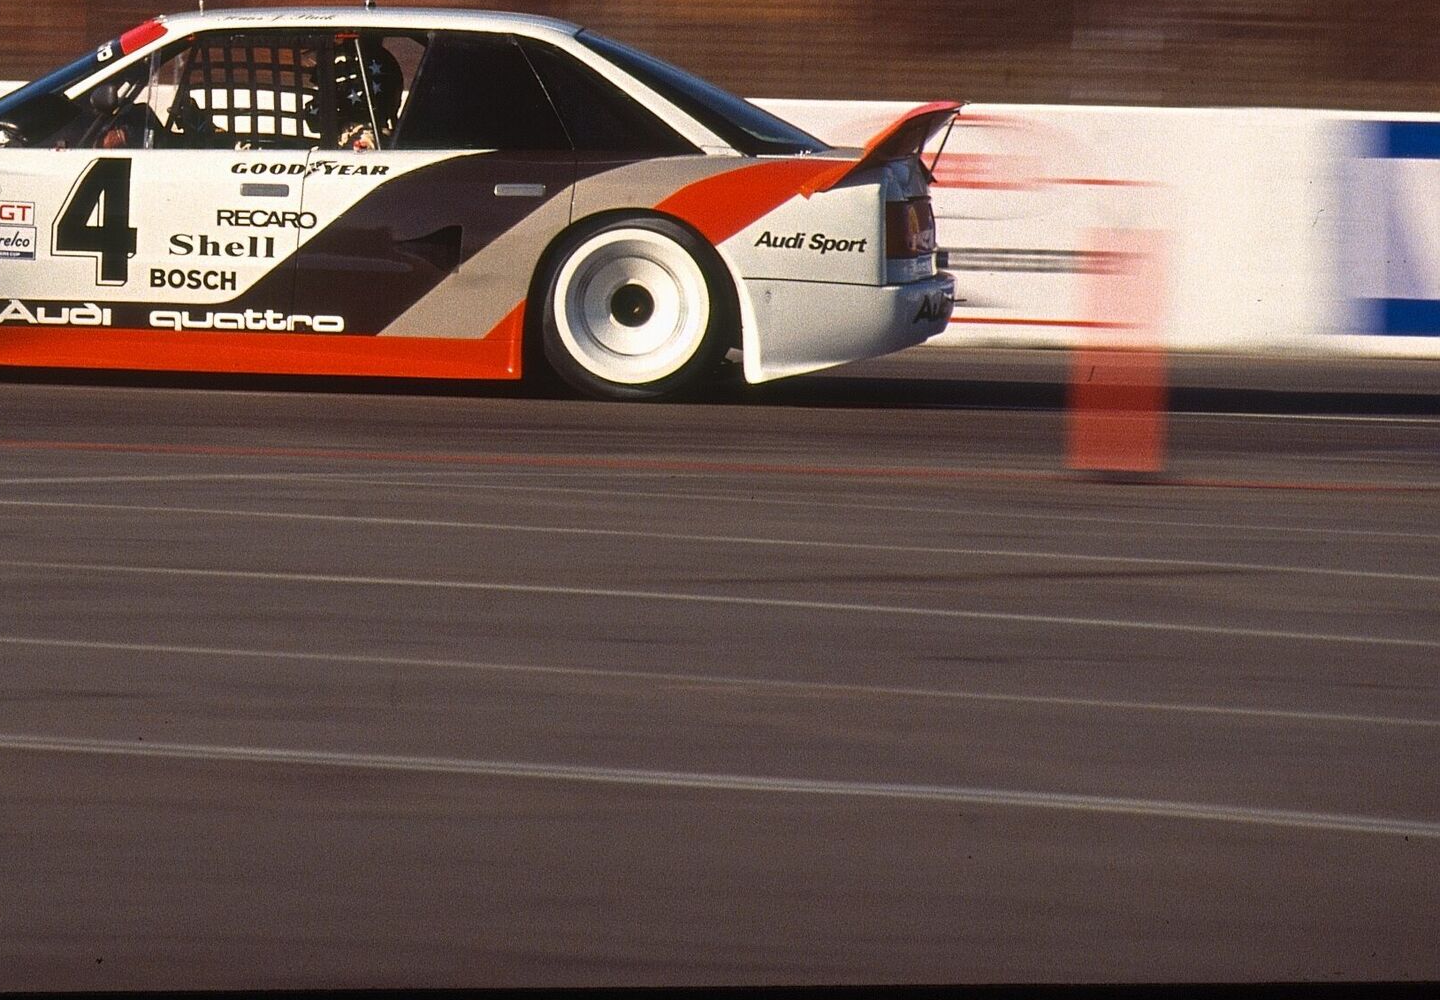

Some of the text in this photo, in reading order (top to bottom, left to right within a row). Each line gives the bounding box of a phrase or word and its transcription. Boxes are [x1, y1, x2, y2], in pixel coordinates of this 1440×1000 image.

[0, 204, 32, 221] GT
[50, 157, 138, 287] 4
[216, 209, 317, 229] RECARO
[168, 233, 275, 258] Shell
[754, 231, 867, 255] Audi Sport
[150, 268, 237, 291] BOSCH
[149, 308, 345, 333] quattro
